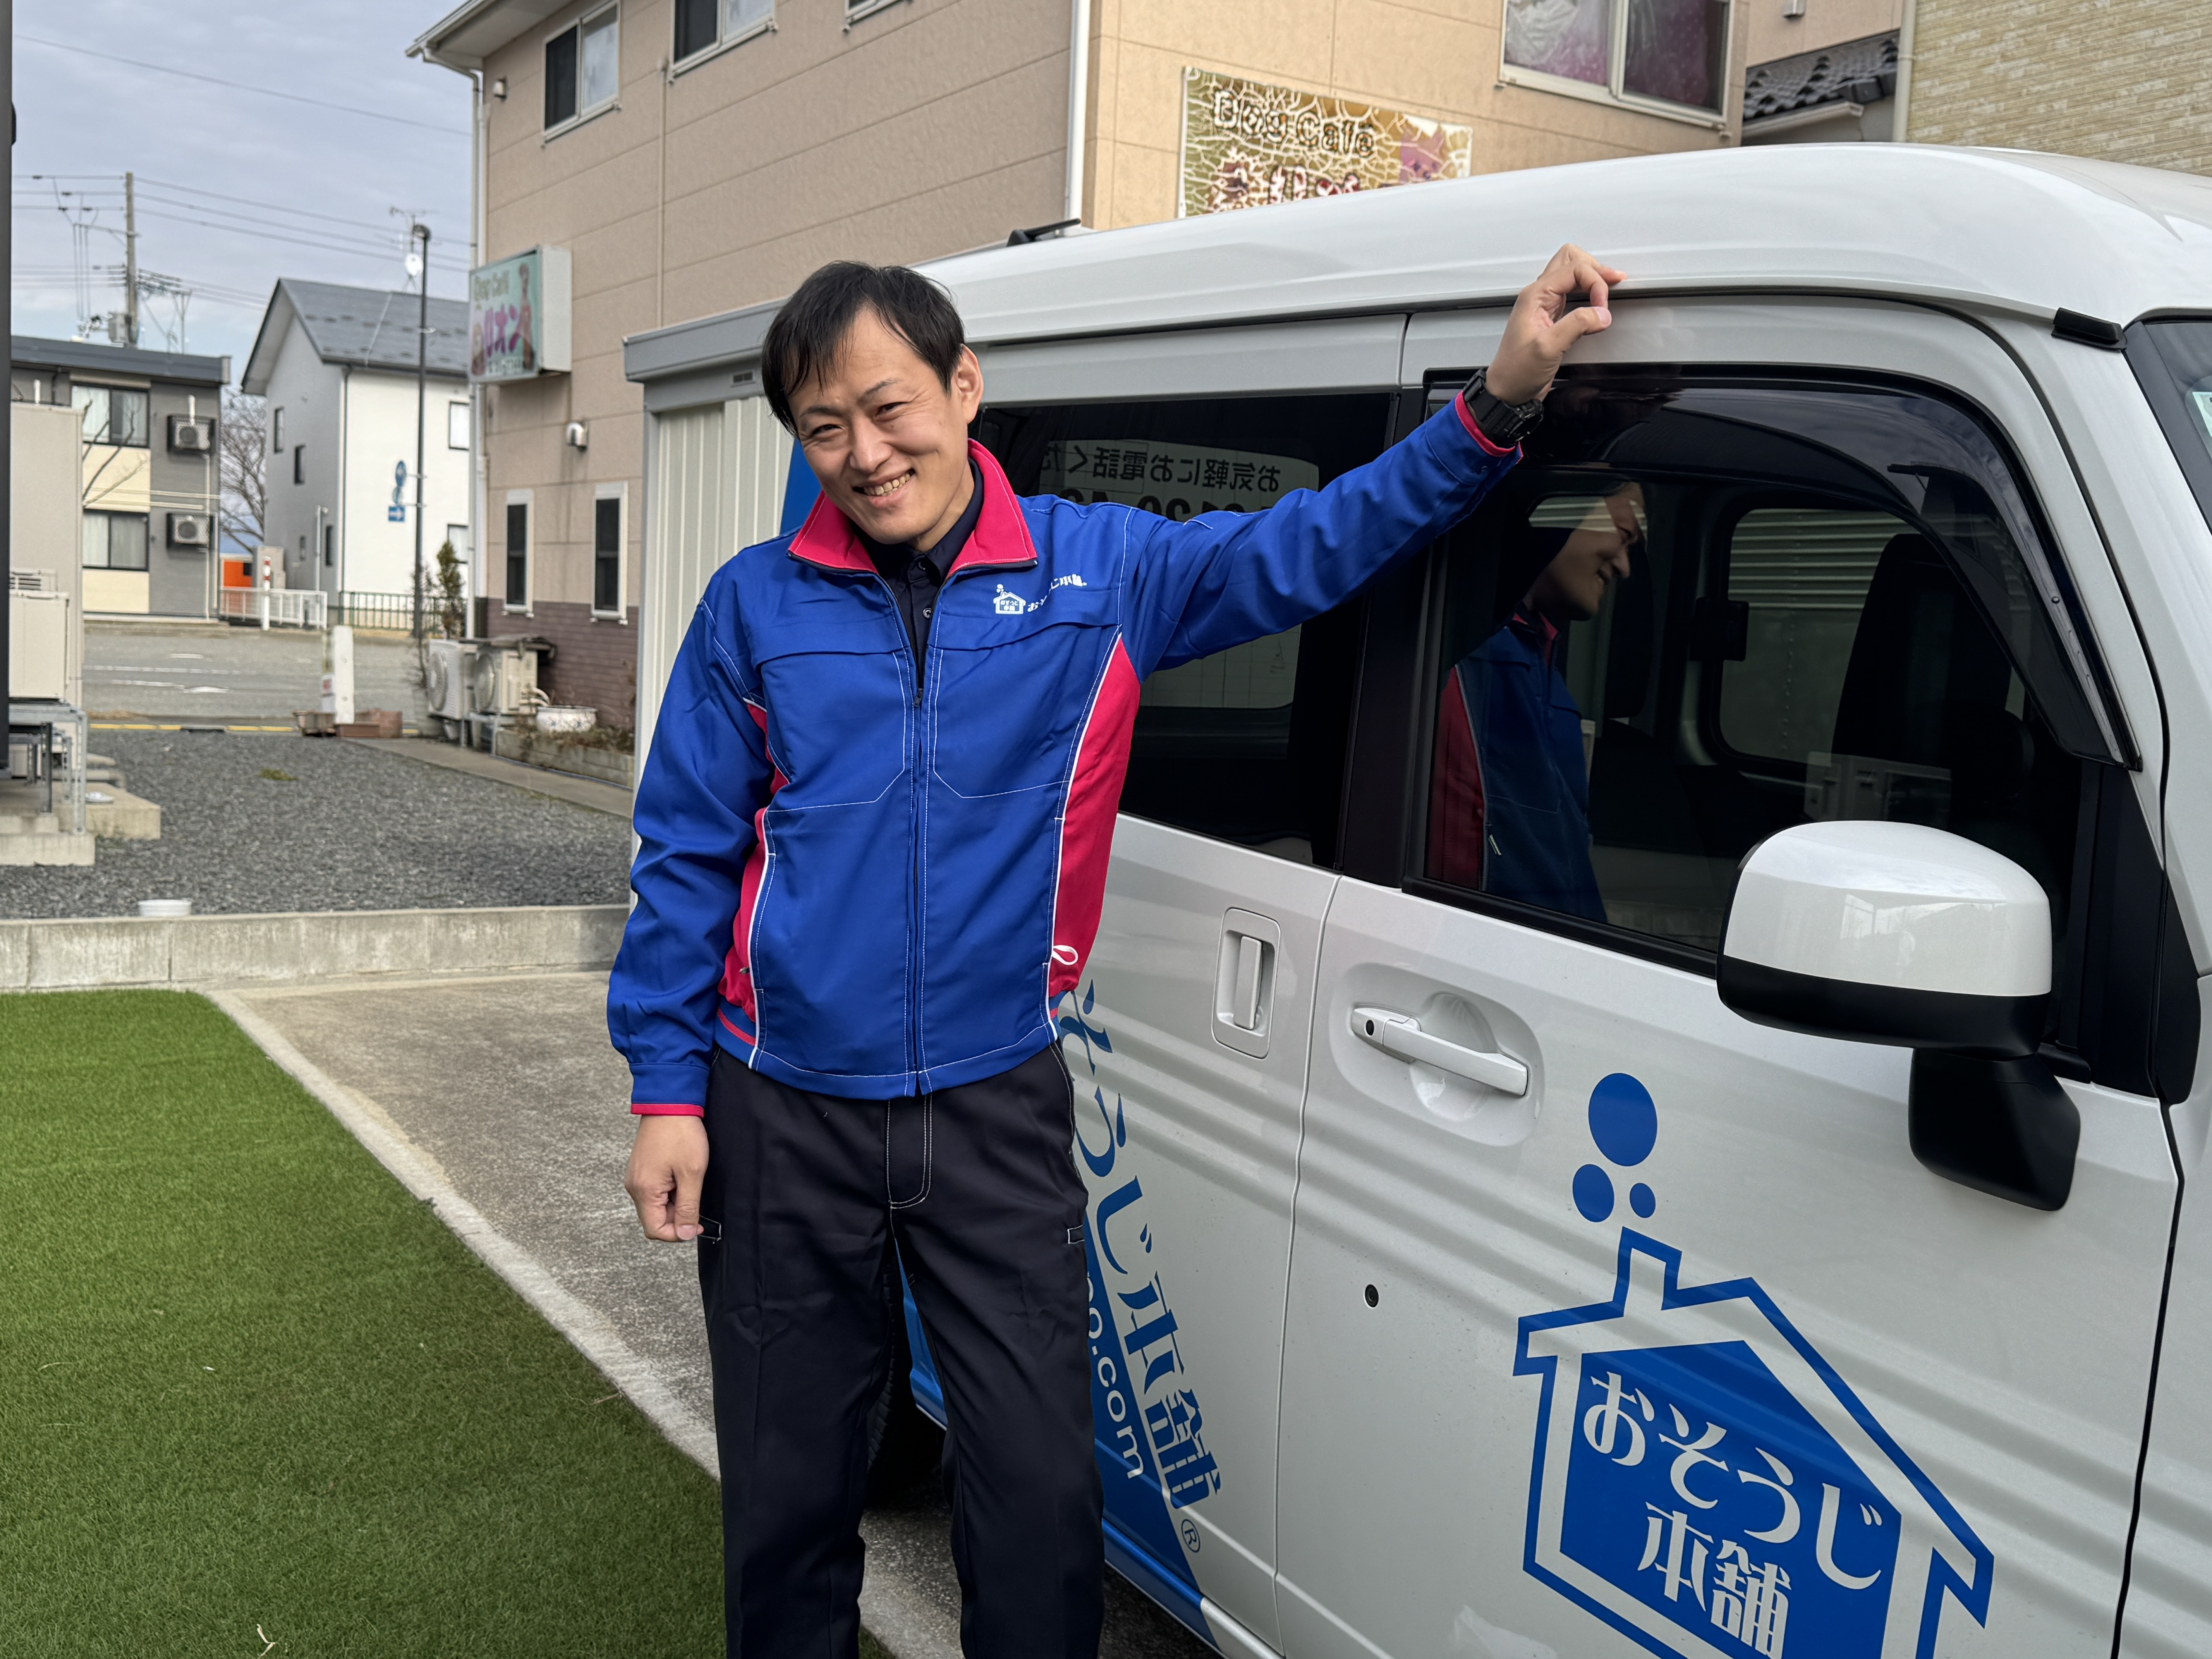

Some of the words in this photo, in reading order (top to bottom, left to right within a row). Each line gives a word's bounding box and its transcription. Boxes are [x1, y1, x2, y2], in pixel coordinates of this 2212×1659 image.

[1214, 90, 1288, 144] Dog
[1583, 1371, 1882, 1589] おそうじ
[1637, 1501, 1792, 1659] 本舗
